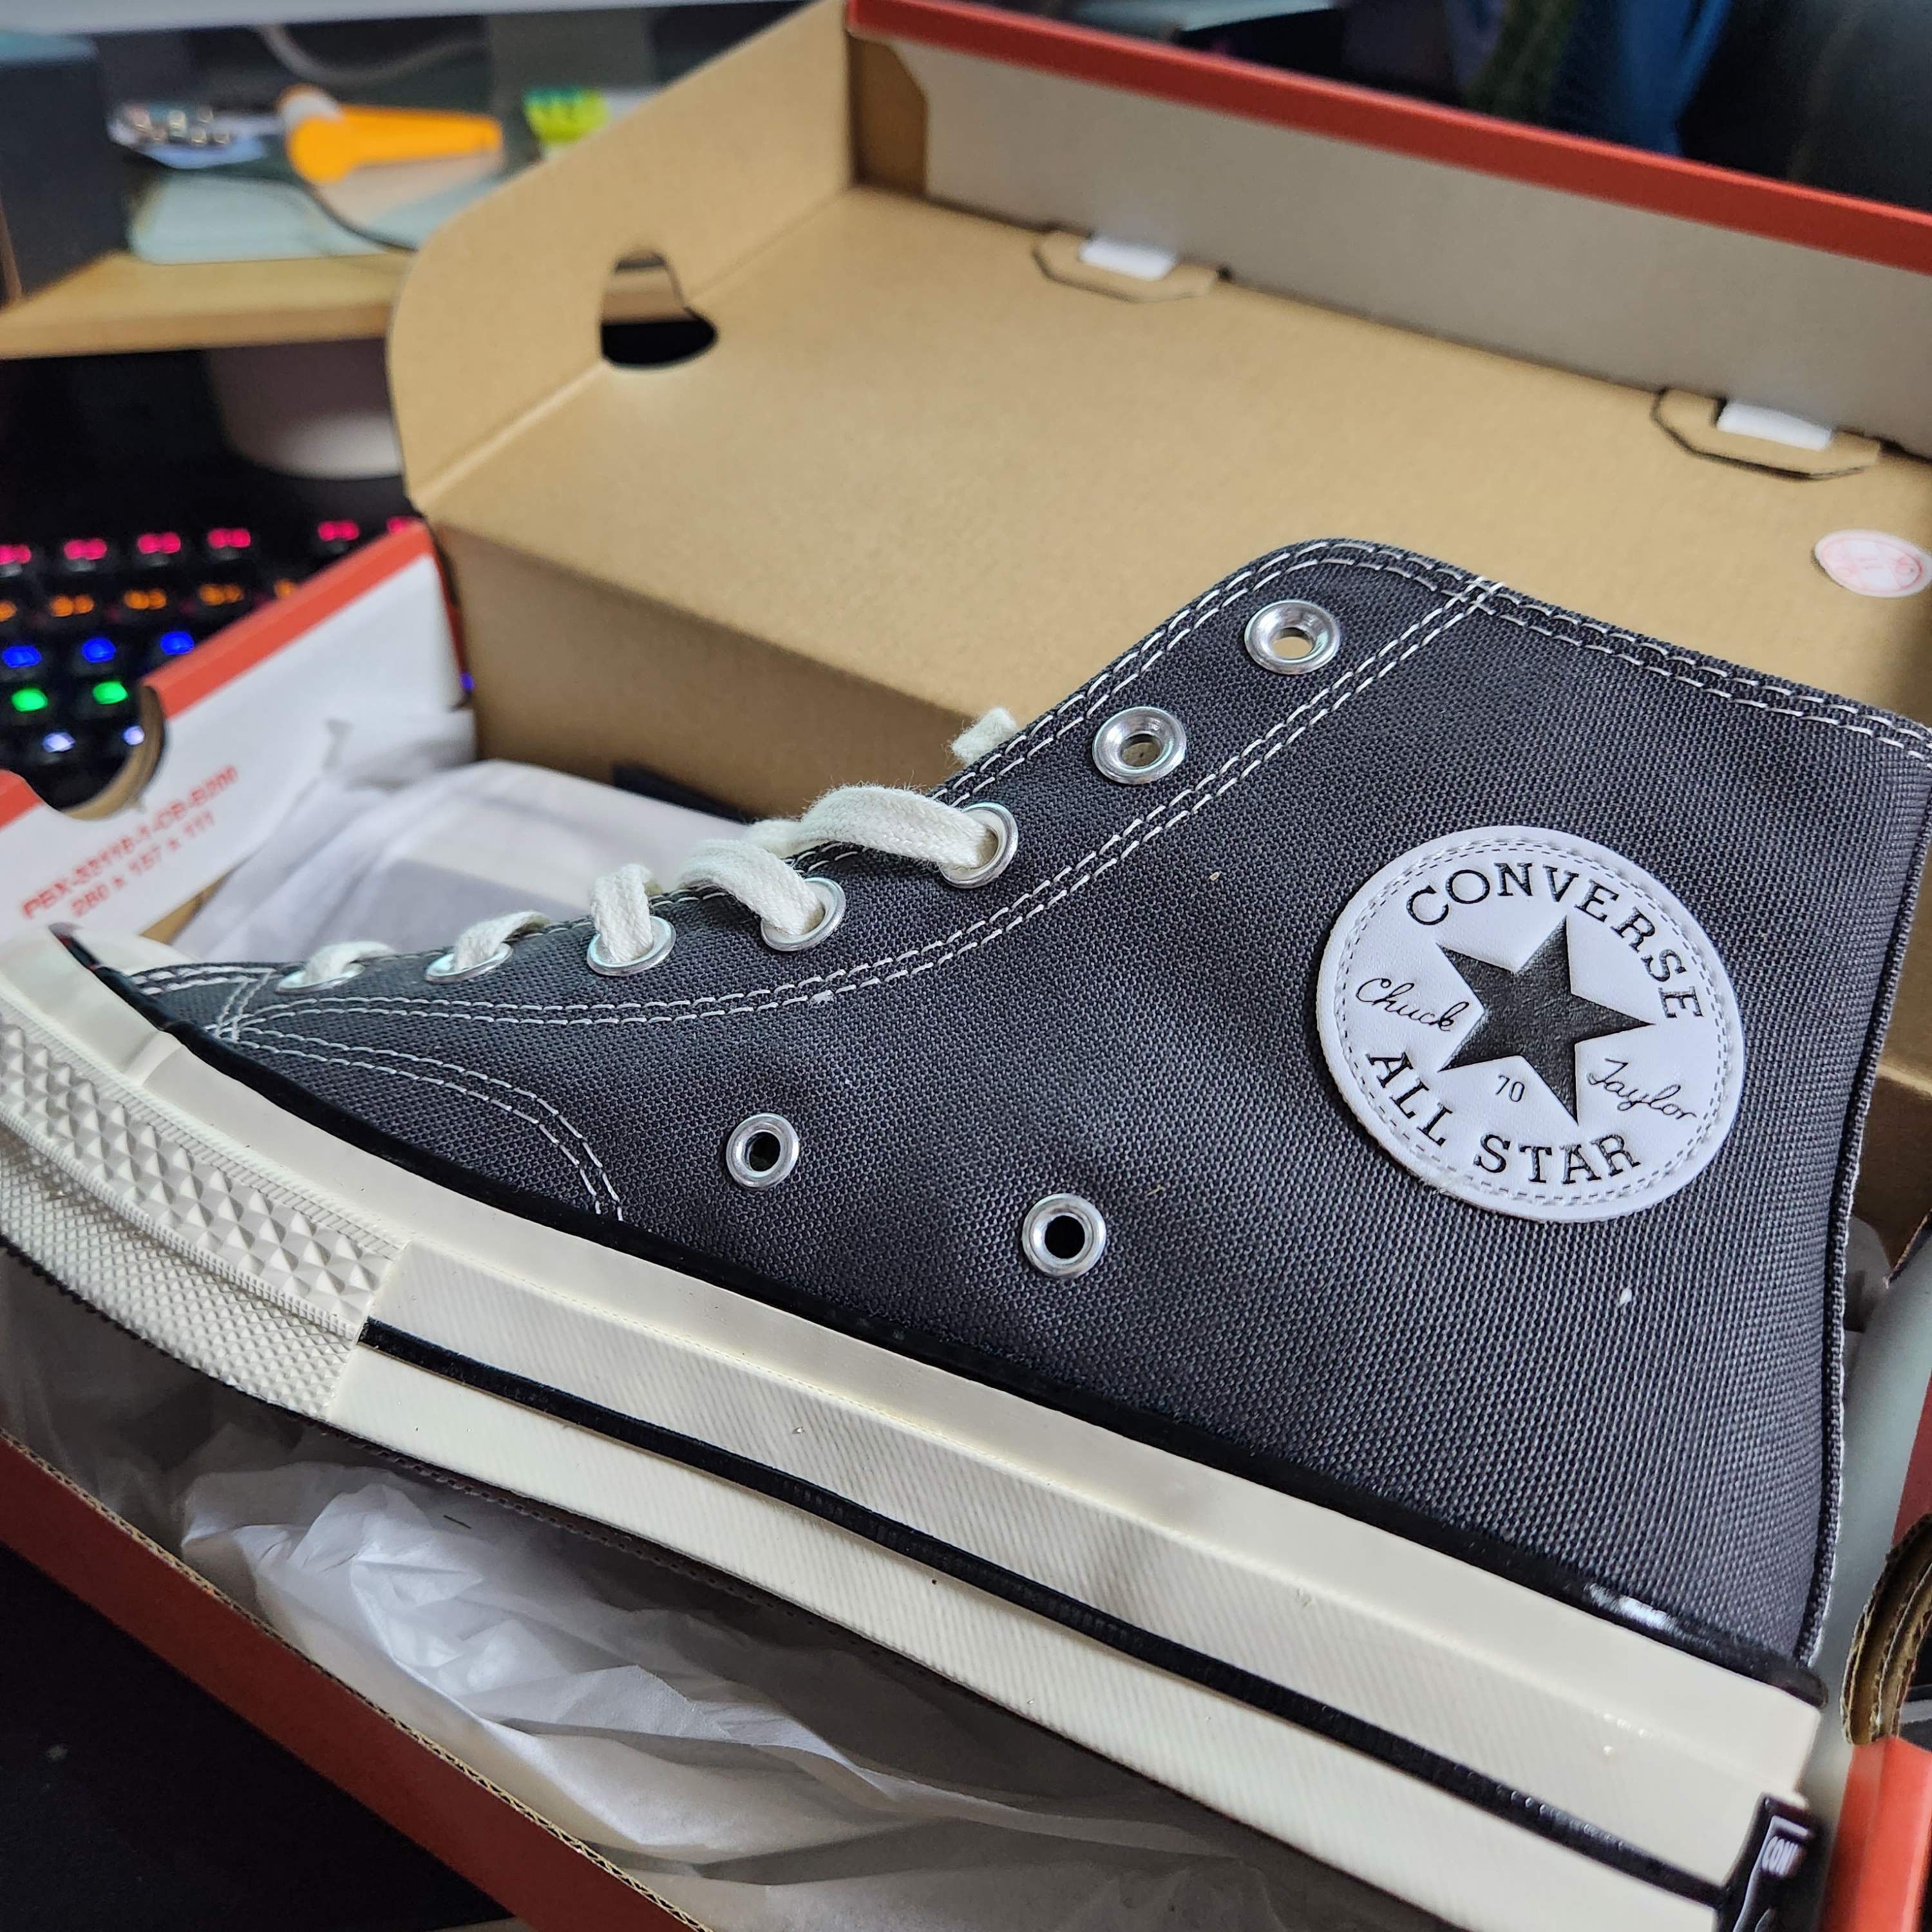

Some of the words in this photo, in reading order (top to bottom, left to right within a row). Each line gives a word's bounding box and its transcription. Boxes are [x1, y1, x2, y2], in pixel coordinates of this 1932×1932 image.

[1406, 862, 1704, 1019] CONVERSE
[1355, 978, 1470, 1032] Chuck
[1365, 1051, 1453, 1147] ALL
[1473, 1133, 1641, 1185] STAR
[1495, 1074, 1525, 1103] 70
[1586, 1057, 1697, 1121] Taylor
